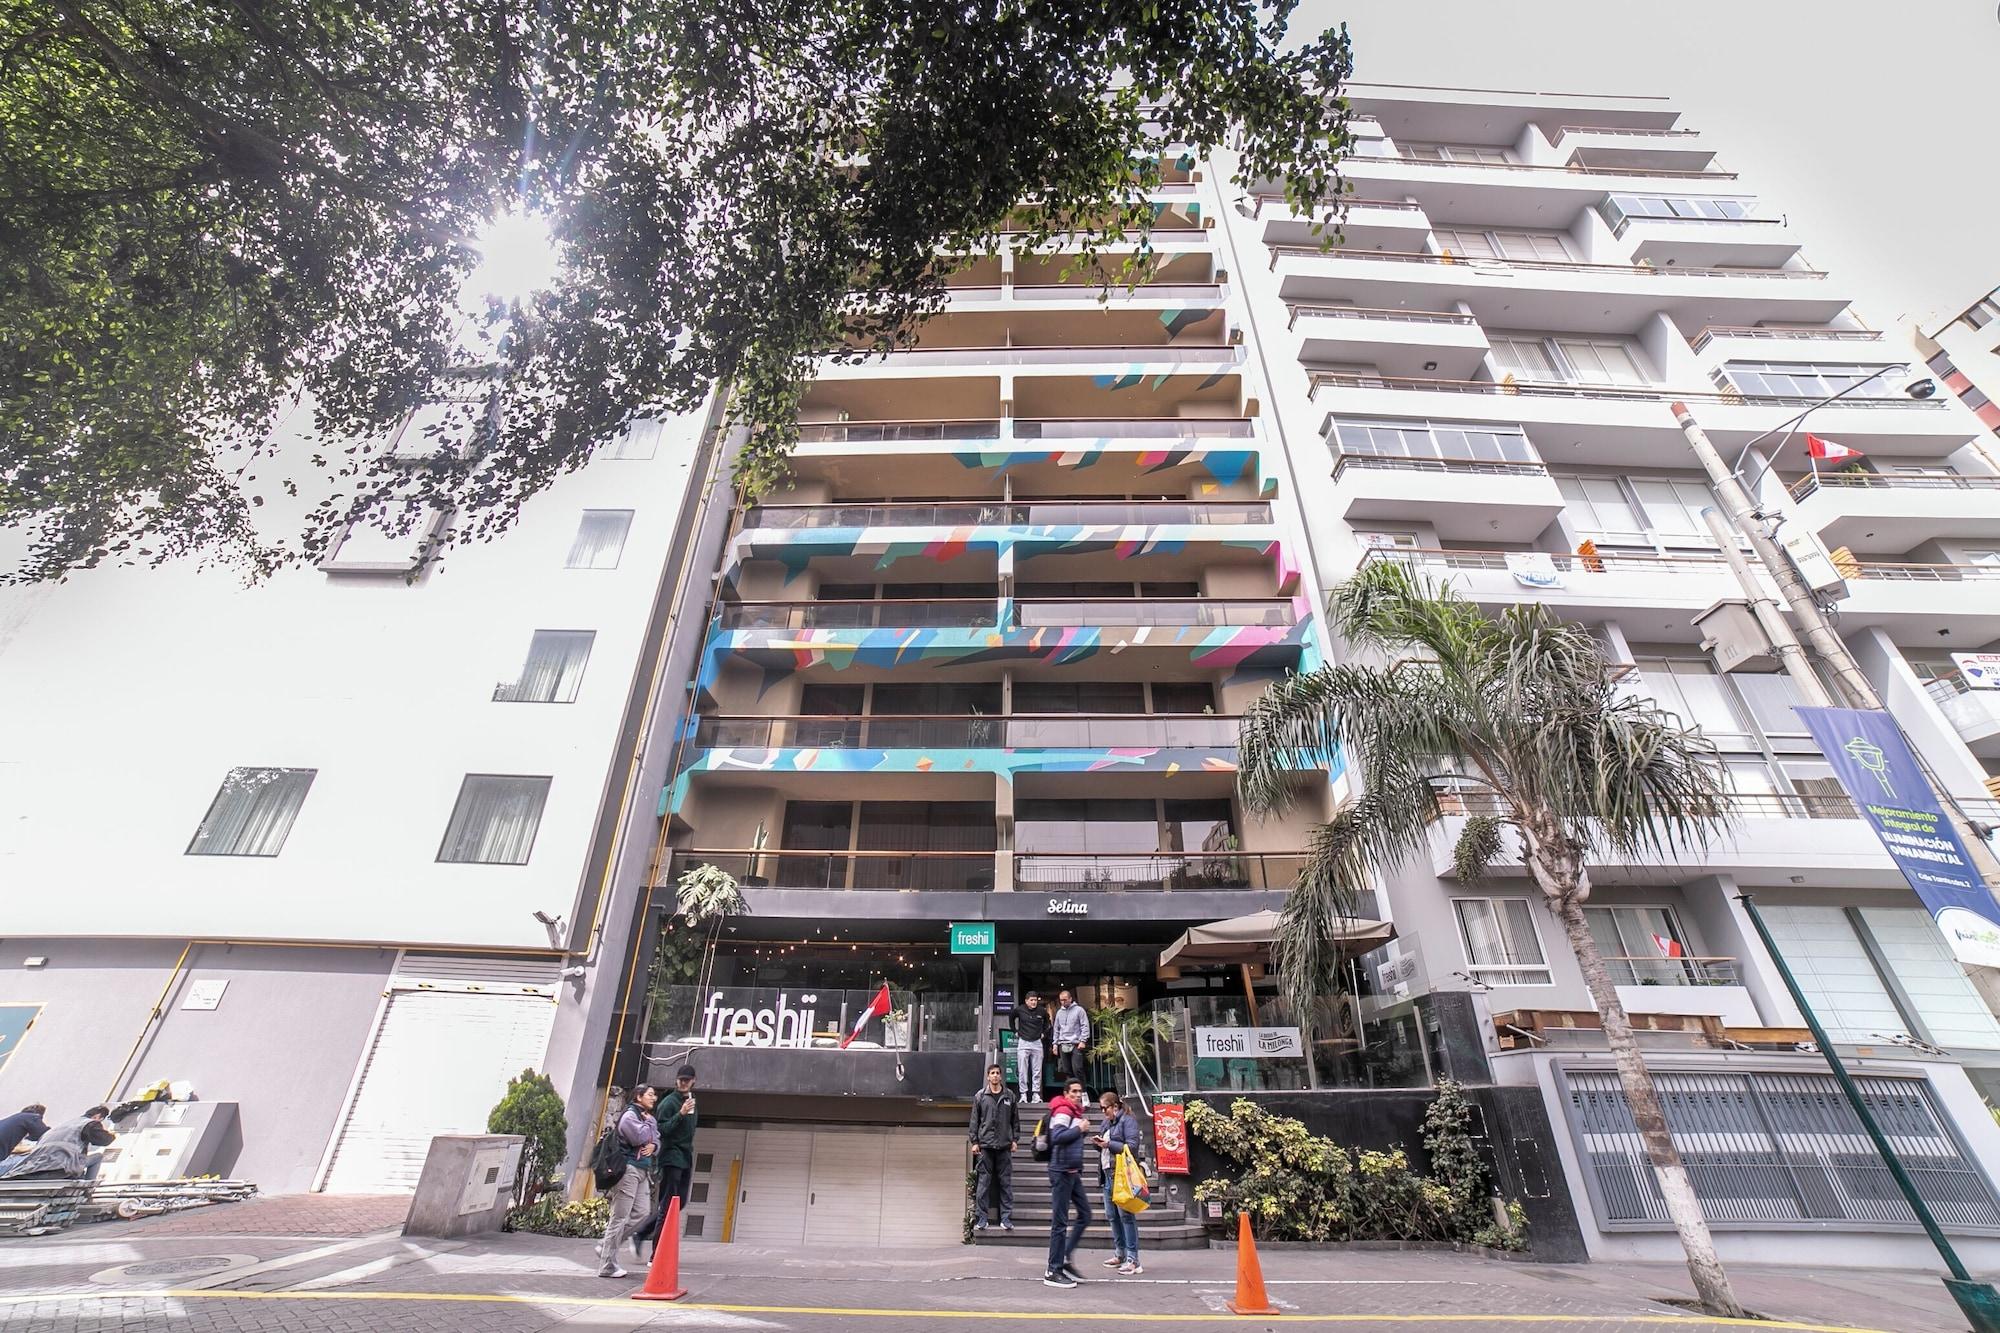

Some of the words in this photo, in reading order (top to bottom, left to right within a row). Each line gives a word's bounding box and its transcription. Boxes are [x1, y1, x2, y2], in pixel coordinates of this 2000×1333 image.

[1867, 805, 1938, 822] Mejoramiento
[1921, 823, 1936, 833] de
[1880, 832, 1955, 851] ILUMINACIÓN
[1889, 845, 1964, 865] ORNAMENTAL
[1047, 898, 1088, 914] Selina
[958, 931, 989, 945] freshii
[703, 991, 817, 1047] freshii
[1206, 1034, 1244, 1052] freshii
[1258, 1040, 1267, 1050] LA
[1267, 1038, 1294, 1050] MILONGA
